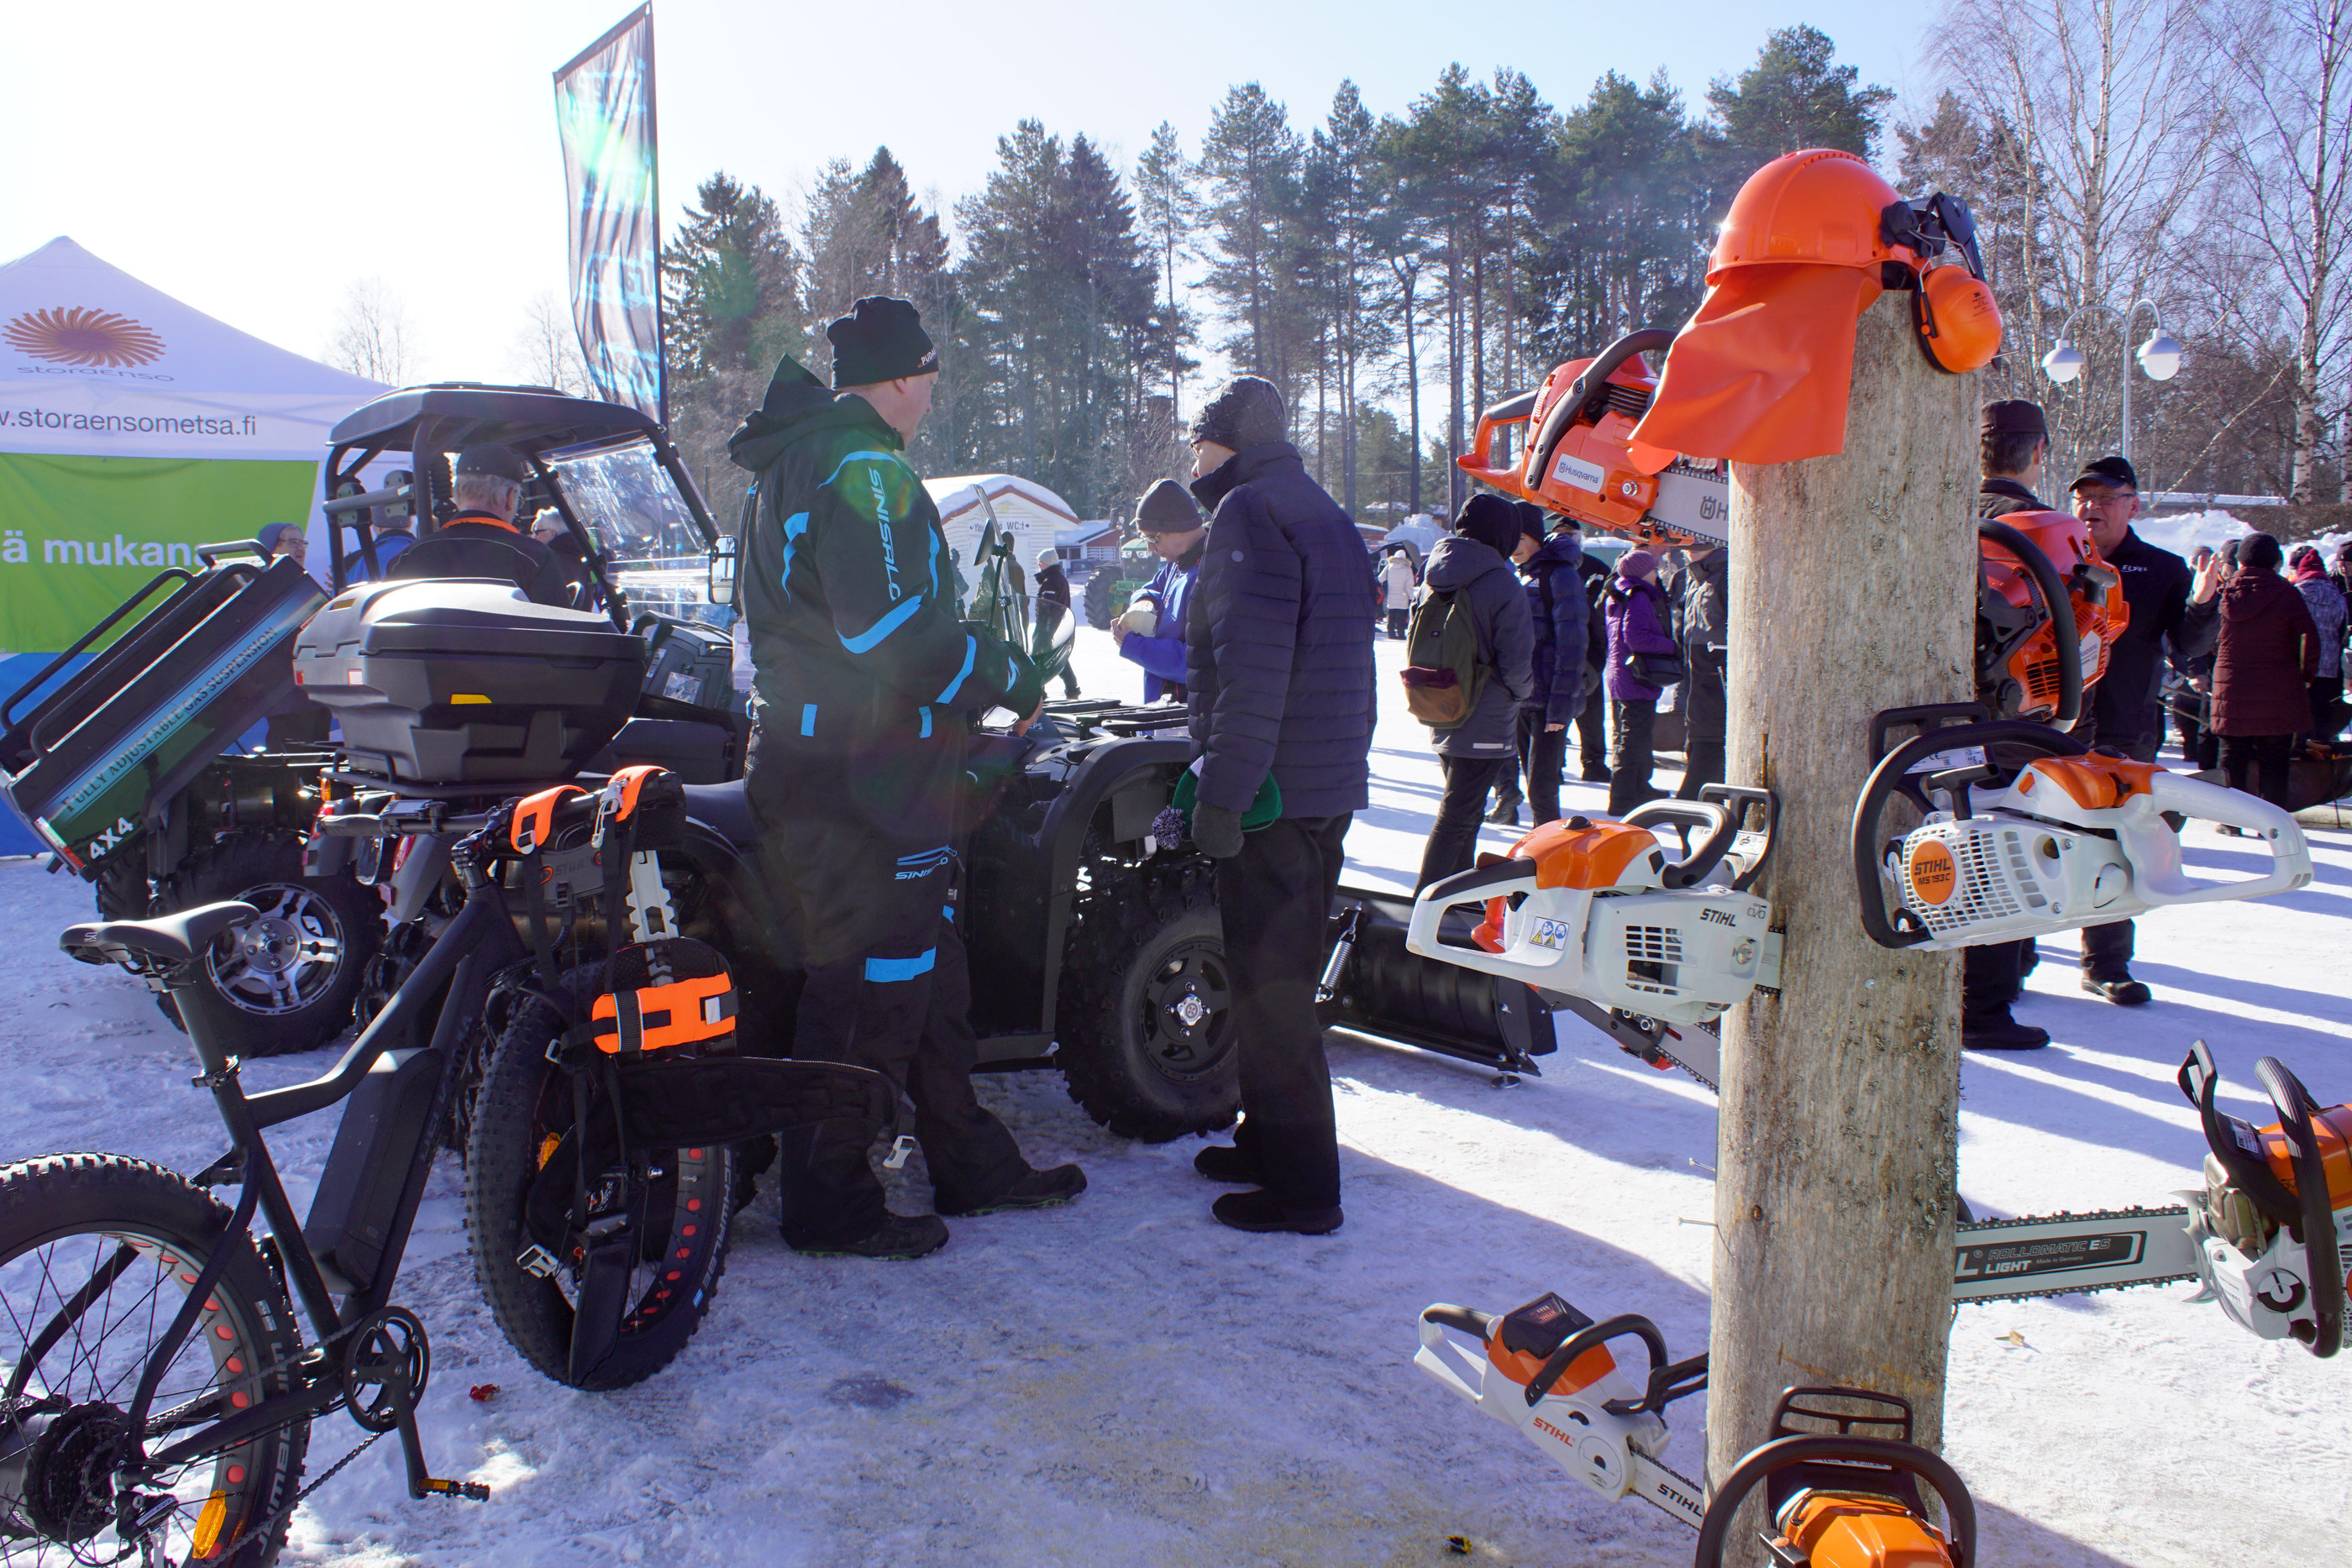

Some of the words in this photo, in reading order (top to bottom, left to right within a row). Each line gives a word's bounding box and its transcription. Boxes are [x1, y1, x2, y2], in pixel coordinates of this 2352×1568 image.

[1565, 466, 1599, 484] Husqvarna
[868, 466, 901, 602] SINISALO
[61, 774, 108, 812] FULLY
[108, 708, 184, 776] ADJUSTABLE
[182, 689, 208, 711] GAS
[207, 627, 277, 691] SUSPENSION
[1914, 858, 1951, 875] STIHL
[1699, 908, 1736, 927] STIHL
[702, 1149, 732, 1289] SCHWALBE
[1988, 1240, 2087, 1260] ROLLOMATIC
[2088, 1239, 2111, 1251] ES
[1955, 1252, 1979, 1277] L
[1984, 1260, 2032, 1274] LIGHT
[1532, 1417, 1574, 1447] STIHL
[1656, 1482, 1703, 1518] STIHL
